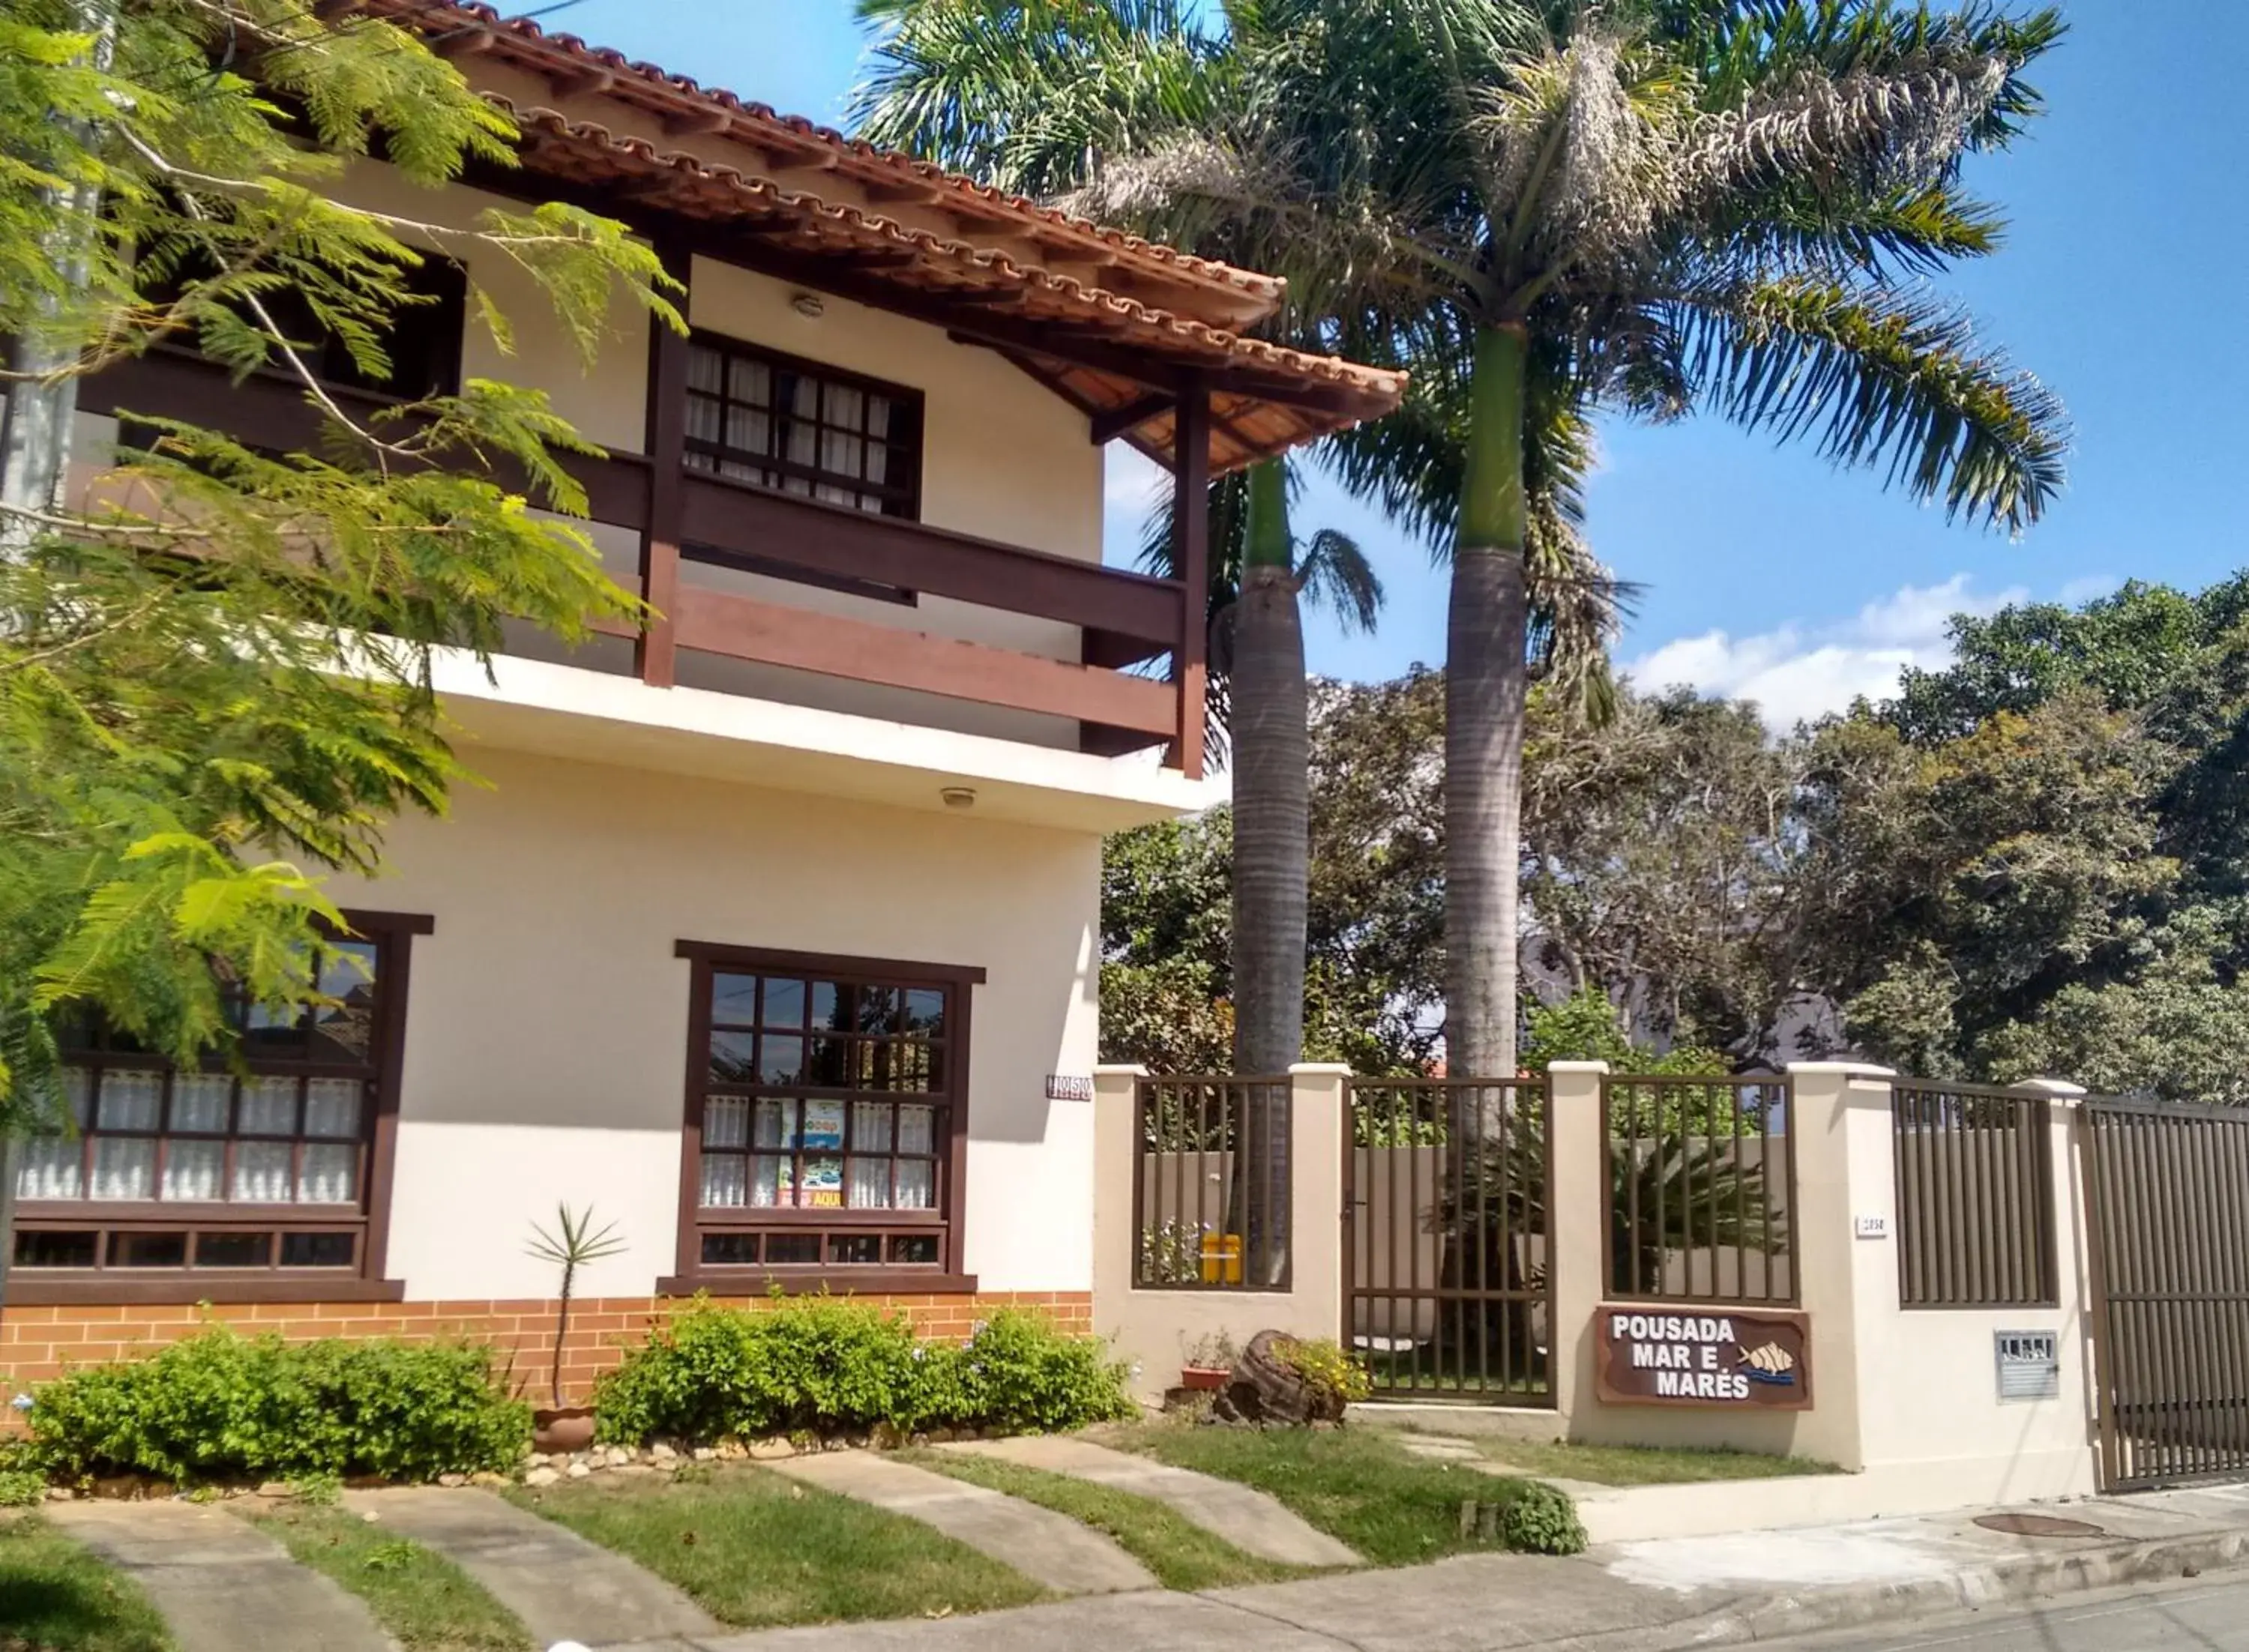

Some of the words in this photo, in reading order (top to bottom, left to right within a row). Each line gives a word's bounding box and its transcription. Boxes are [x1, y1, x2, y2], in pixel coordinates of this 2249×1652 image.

[1612, 1315, 1735, 1342] POUSADA
[1632, 1343, 1691, 1369] MAR
[1701, 1345, 1718, 1369] E
[1656, 1367, 1750, 1399] MARÉS
